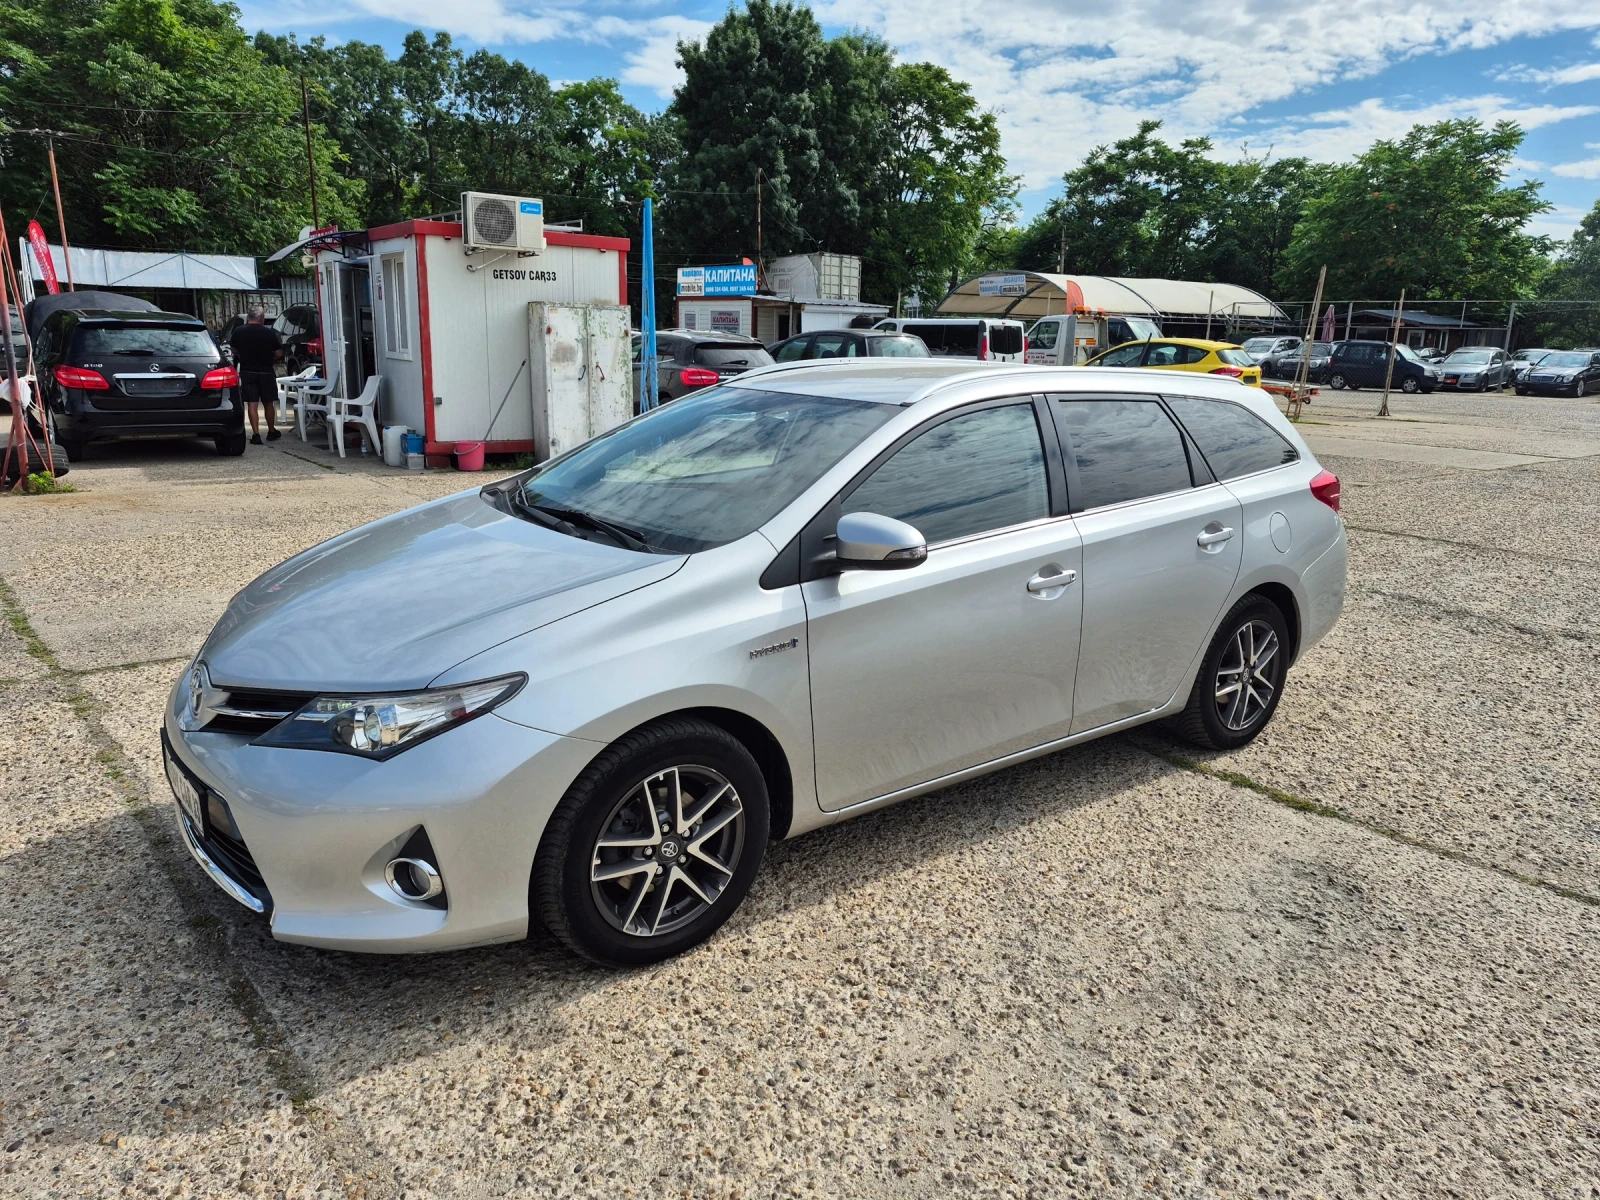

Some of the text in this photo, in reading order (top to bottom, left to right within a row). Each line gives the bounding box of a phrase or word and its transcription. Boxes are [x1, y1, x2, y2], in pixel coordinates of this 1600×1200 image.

[493, 269, 557, 282] GETSOV CAR33
[705, 268, 756, 283] КАПИТАНА
[1003, 276, 1025, 284] BGAUTO
[681, 283, 703, 293] mobile.bg
